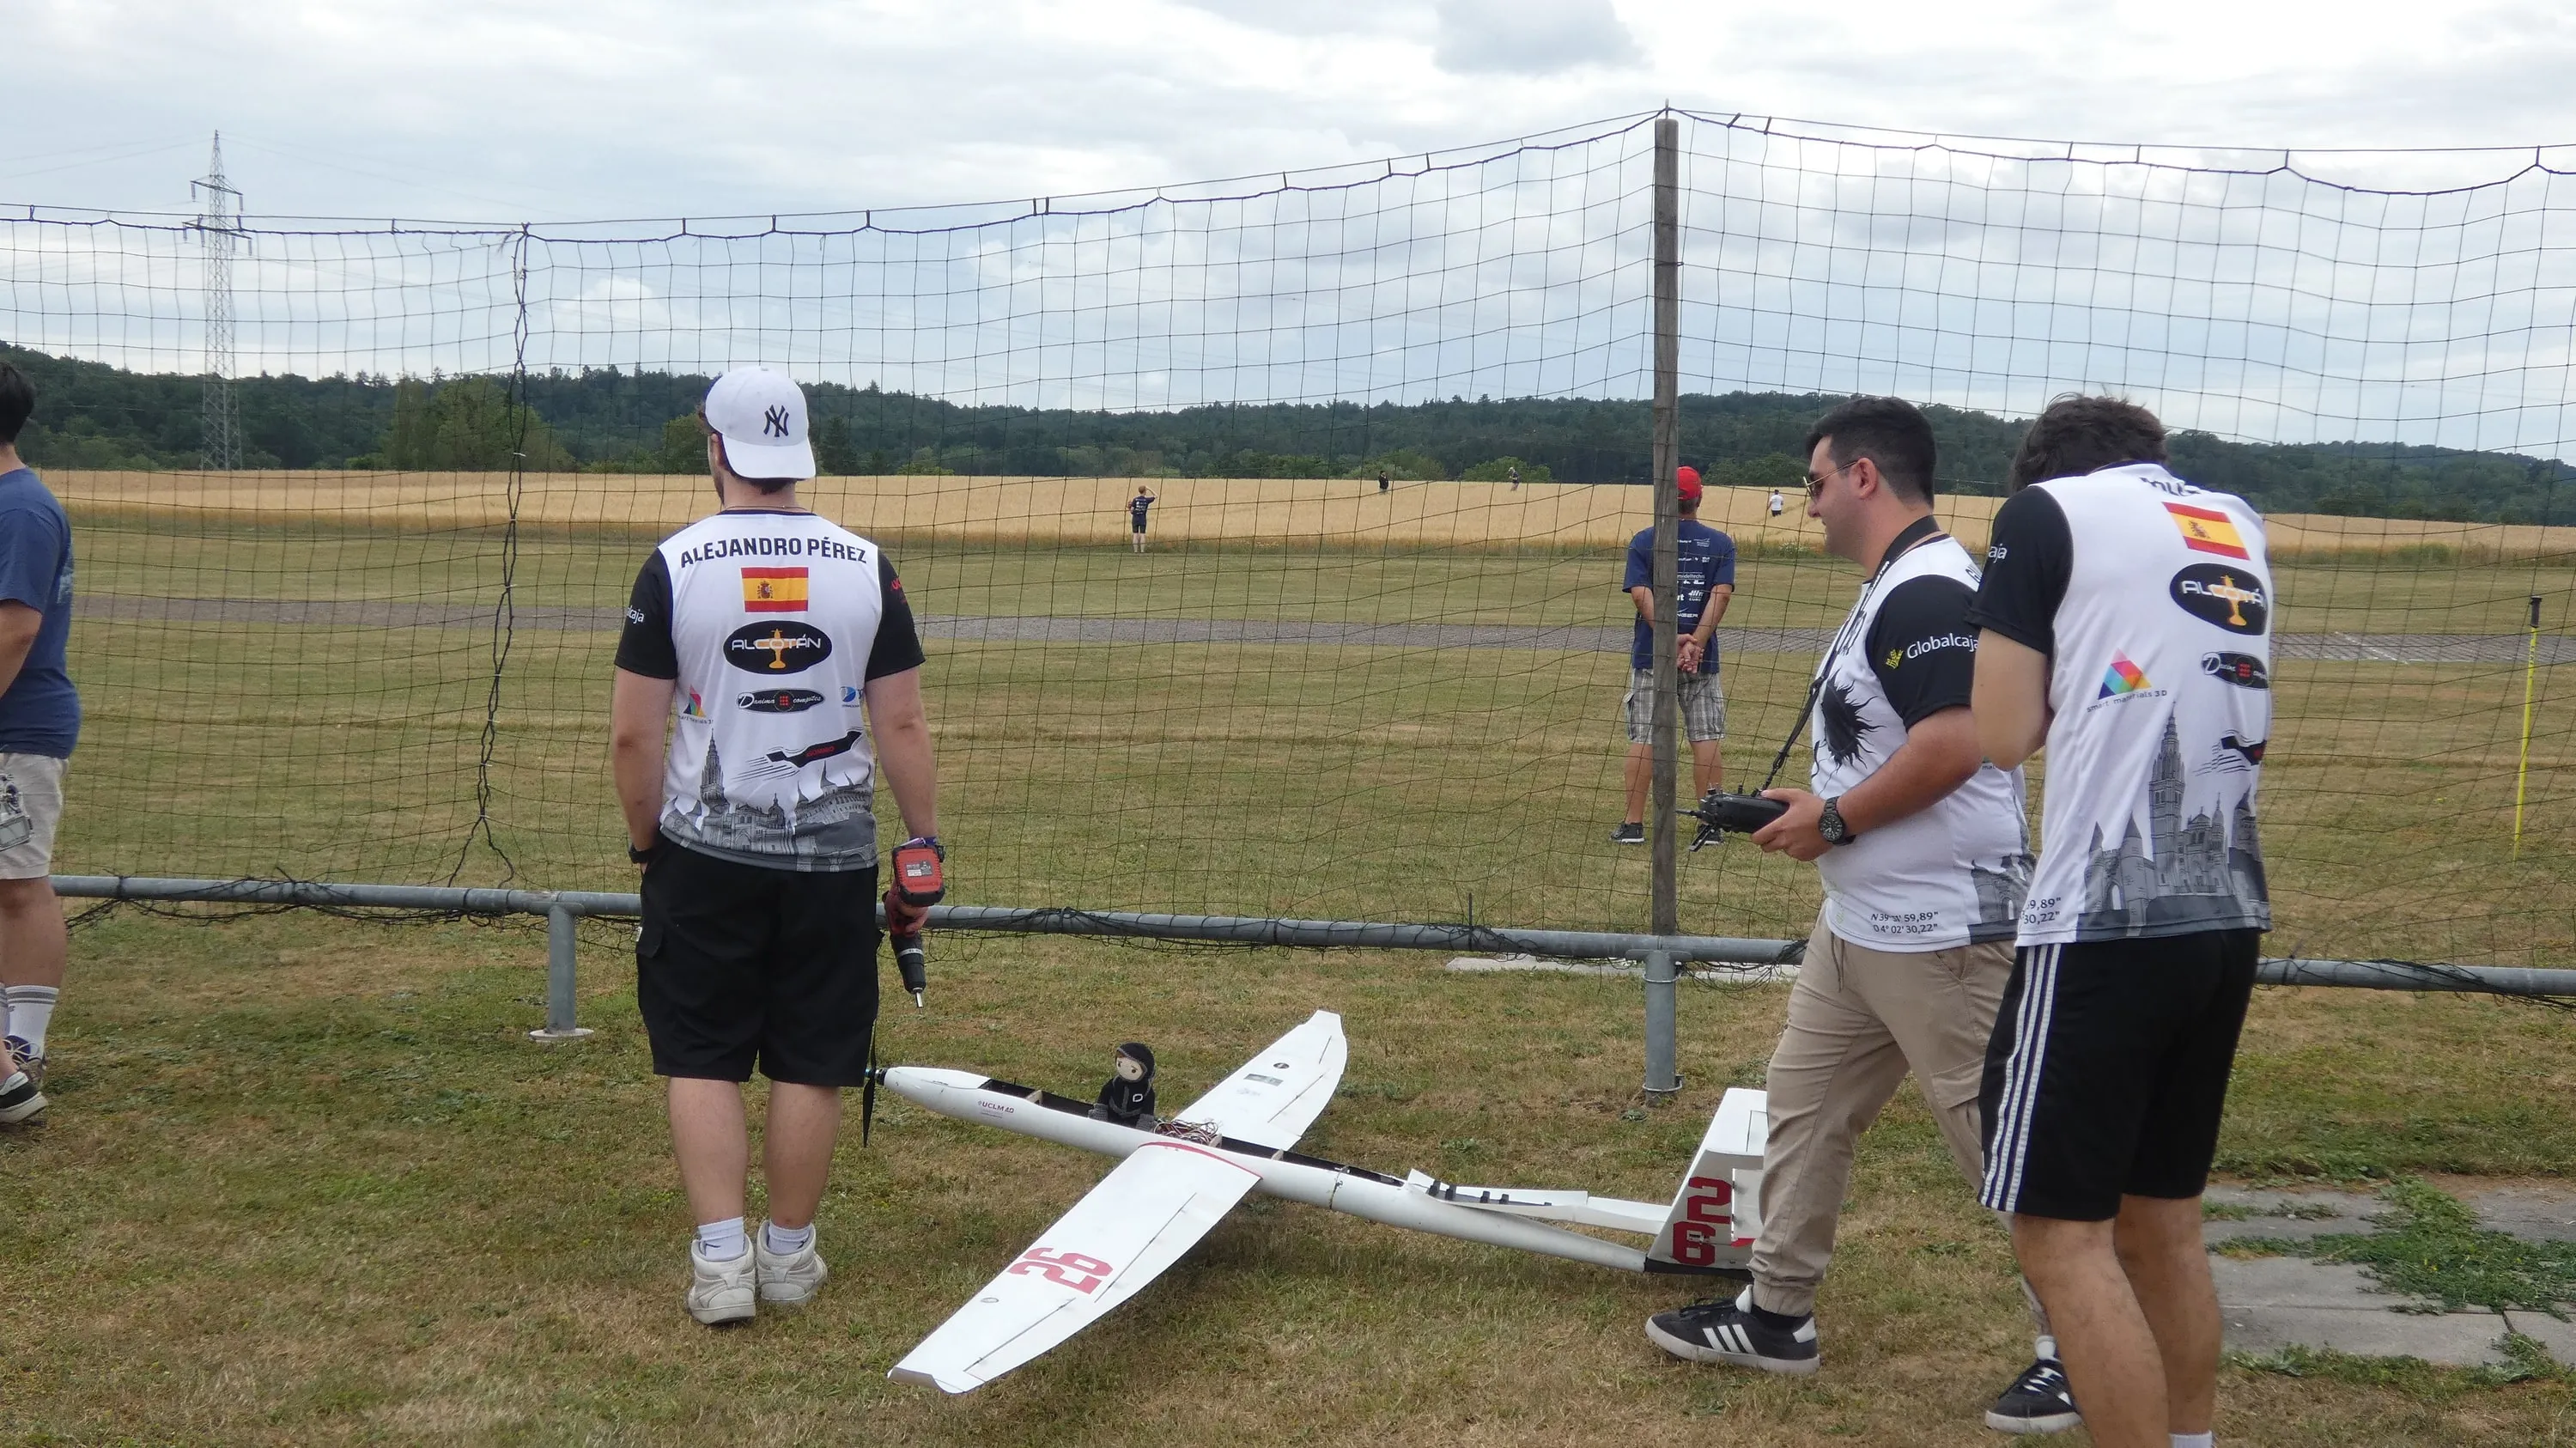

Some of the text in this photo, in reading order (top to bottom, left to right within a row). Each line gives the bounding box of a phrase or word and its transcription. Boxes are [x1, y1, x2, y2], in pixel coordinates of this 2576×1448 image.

[763, 405, 789, 437] NY
[681, 536, 867, 569] ALEJANDRO PÉREZ
[732, 634, 822, 651] ALCOTÁN
[2087, 700, 2109, 713] smart
[982, 1101, 1005, 1111] UCLM
[1006, 1247, 1113, 1294] 26
